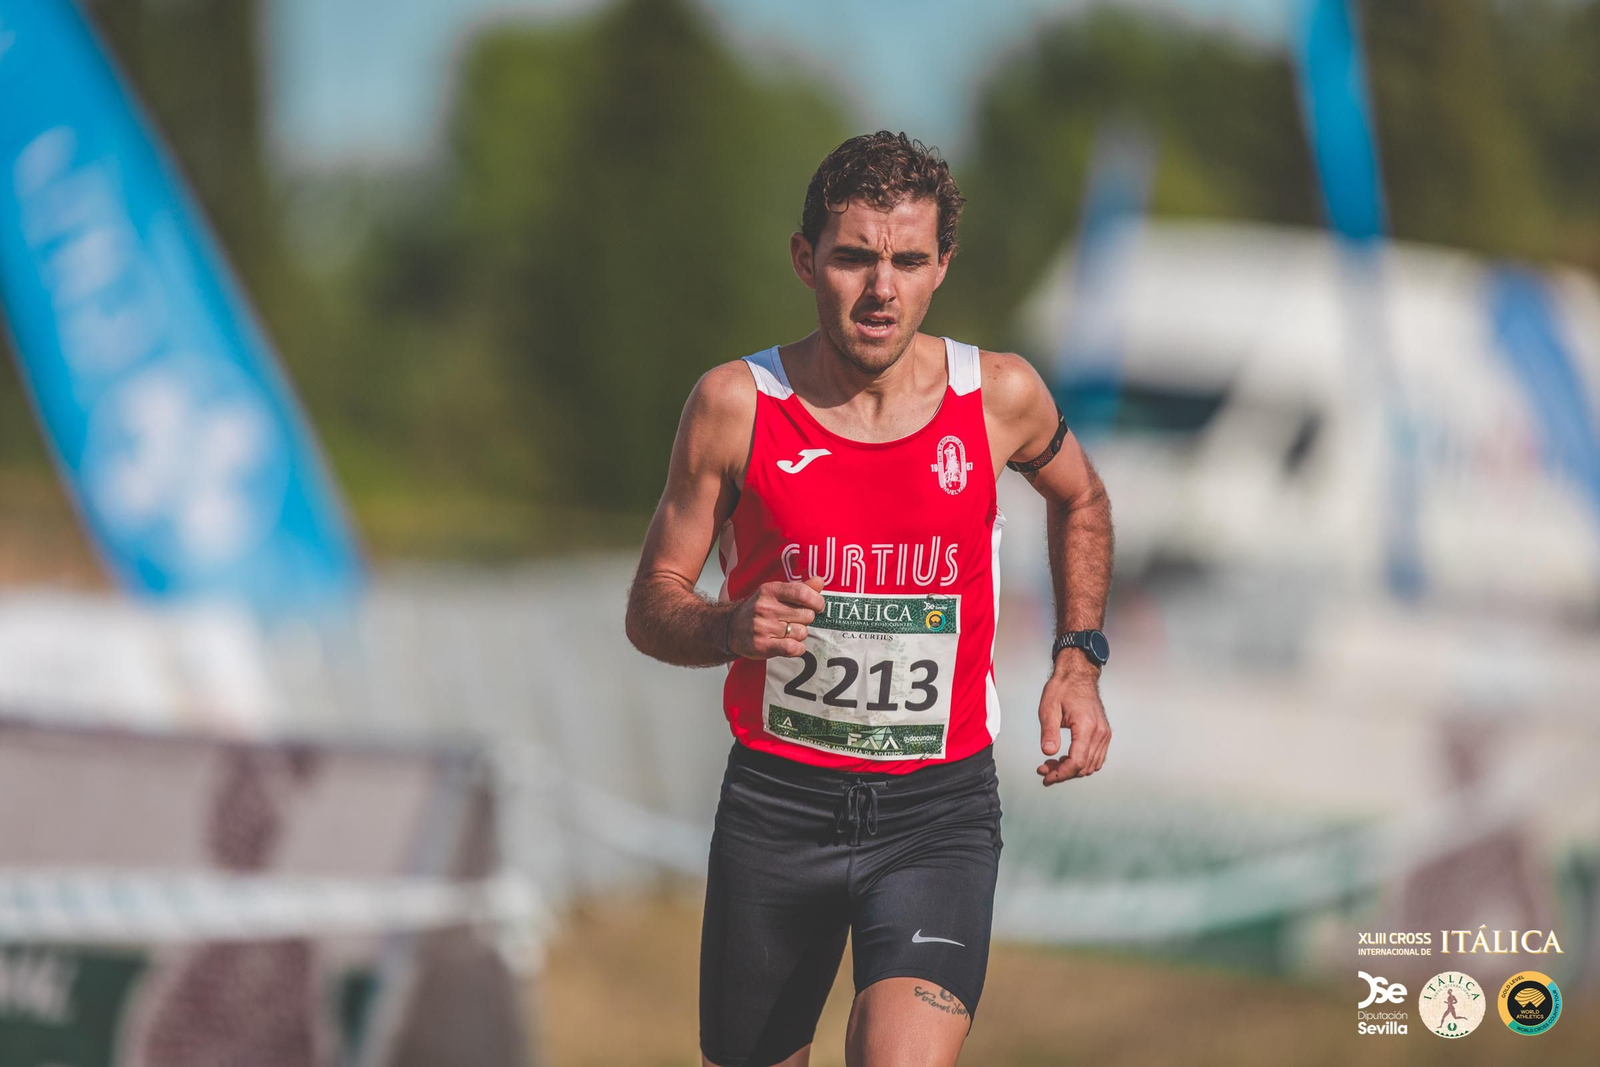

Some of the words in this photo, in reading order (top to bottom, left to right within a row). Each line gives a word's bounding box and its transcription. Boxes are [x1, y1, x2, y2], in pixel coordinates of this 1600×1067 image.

[781, 536, 959, 593] CURTIUS
[826, 598, 913, 622] ITÁLICA
[859, 633, 894, 641] CURTIUS
[784, 650, 940, 712] 2213
